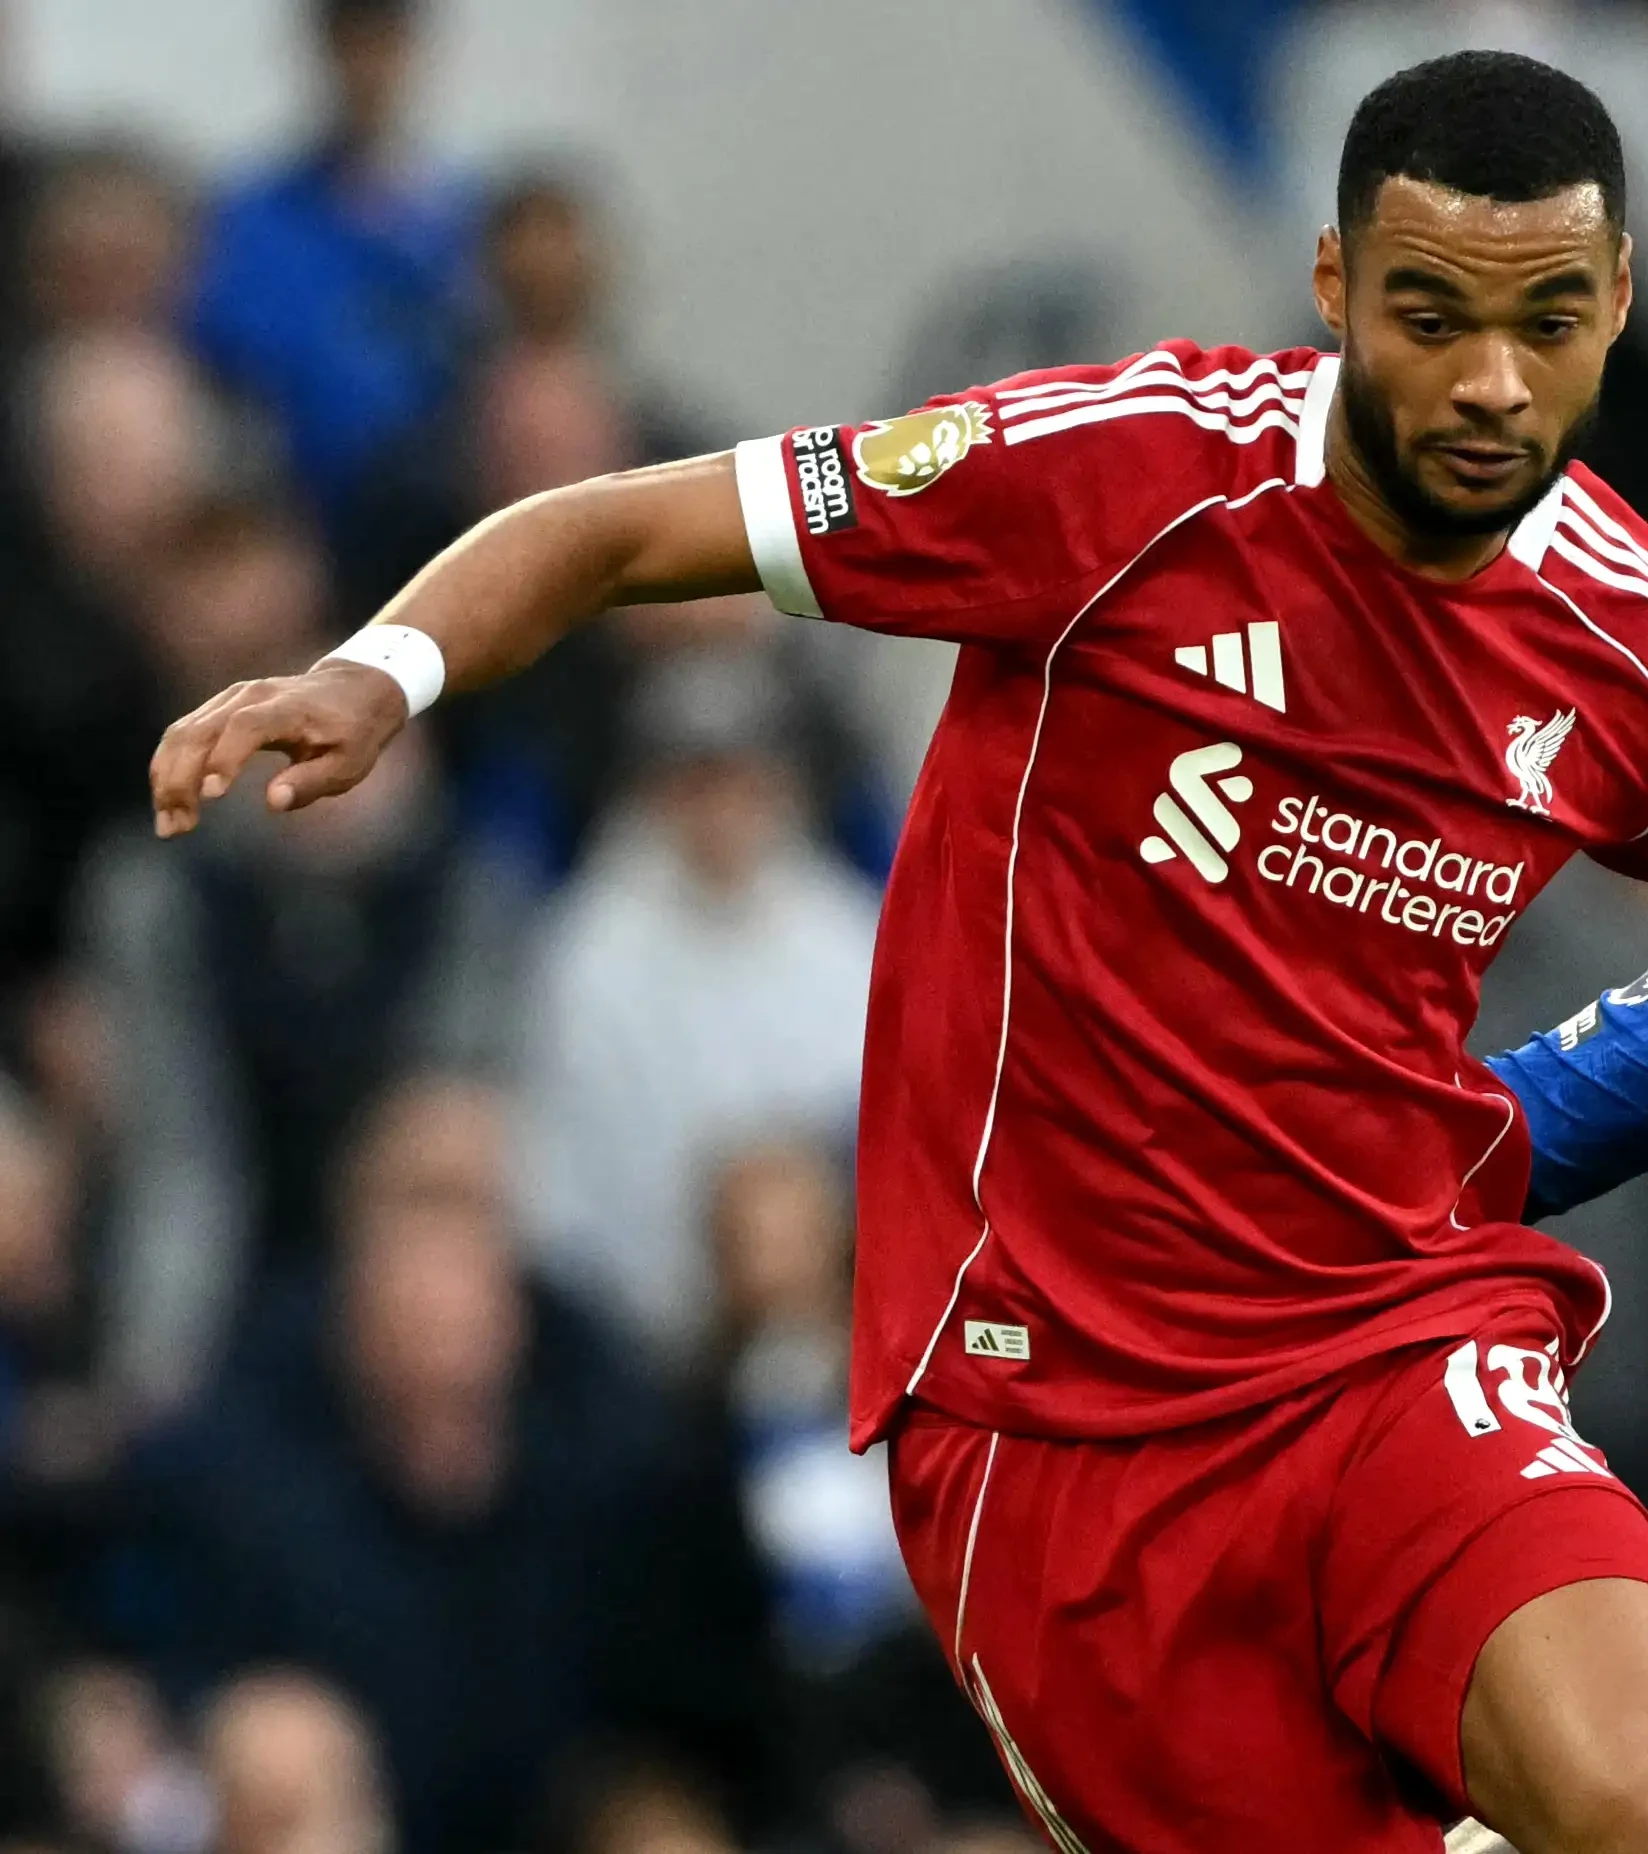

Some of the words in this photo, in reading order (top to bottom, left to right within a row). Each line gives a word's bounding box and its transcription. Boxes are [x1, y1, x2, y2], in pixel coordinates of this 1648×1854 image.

[819, 448, 849, 518] room
[1257, 843, 1516, 947] chartered
[1271, 795, 1524, 905] standard
